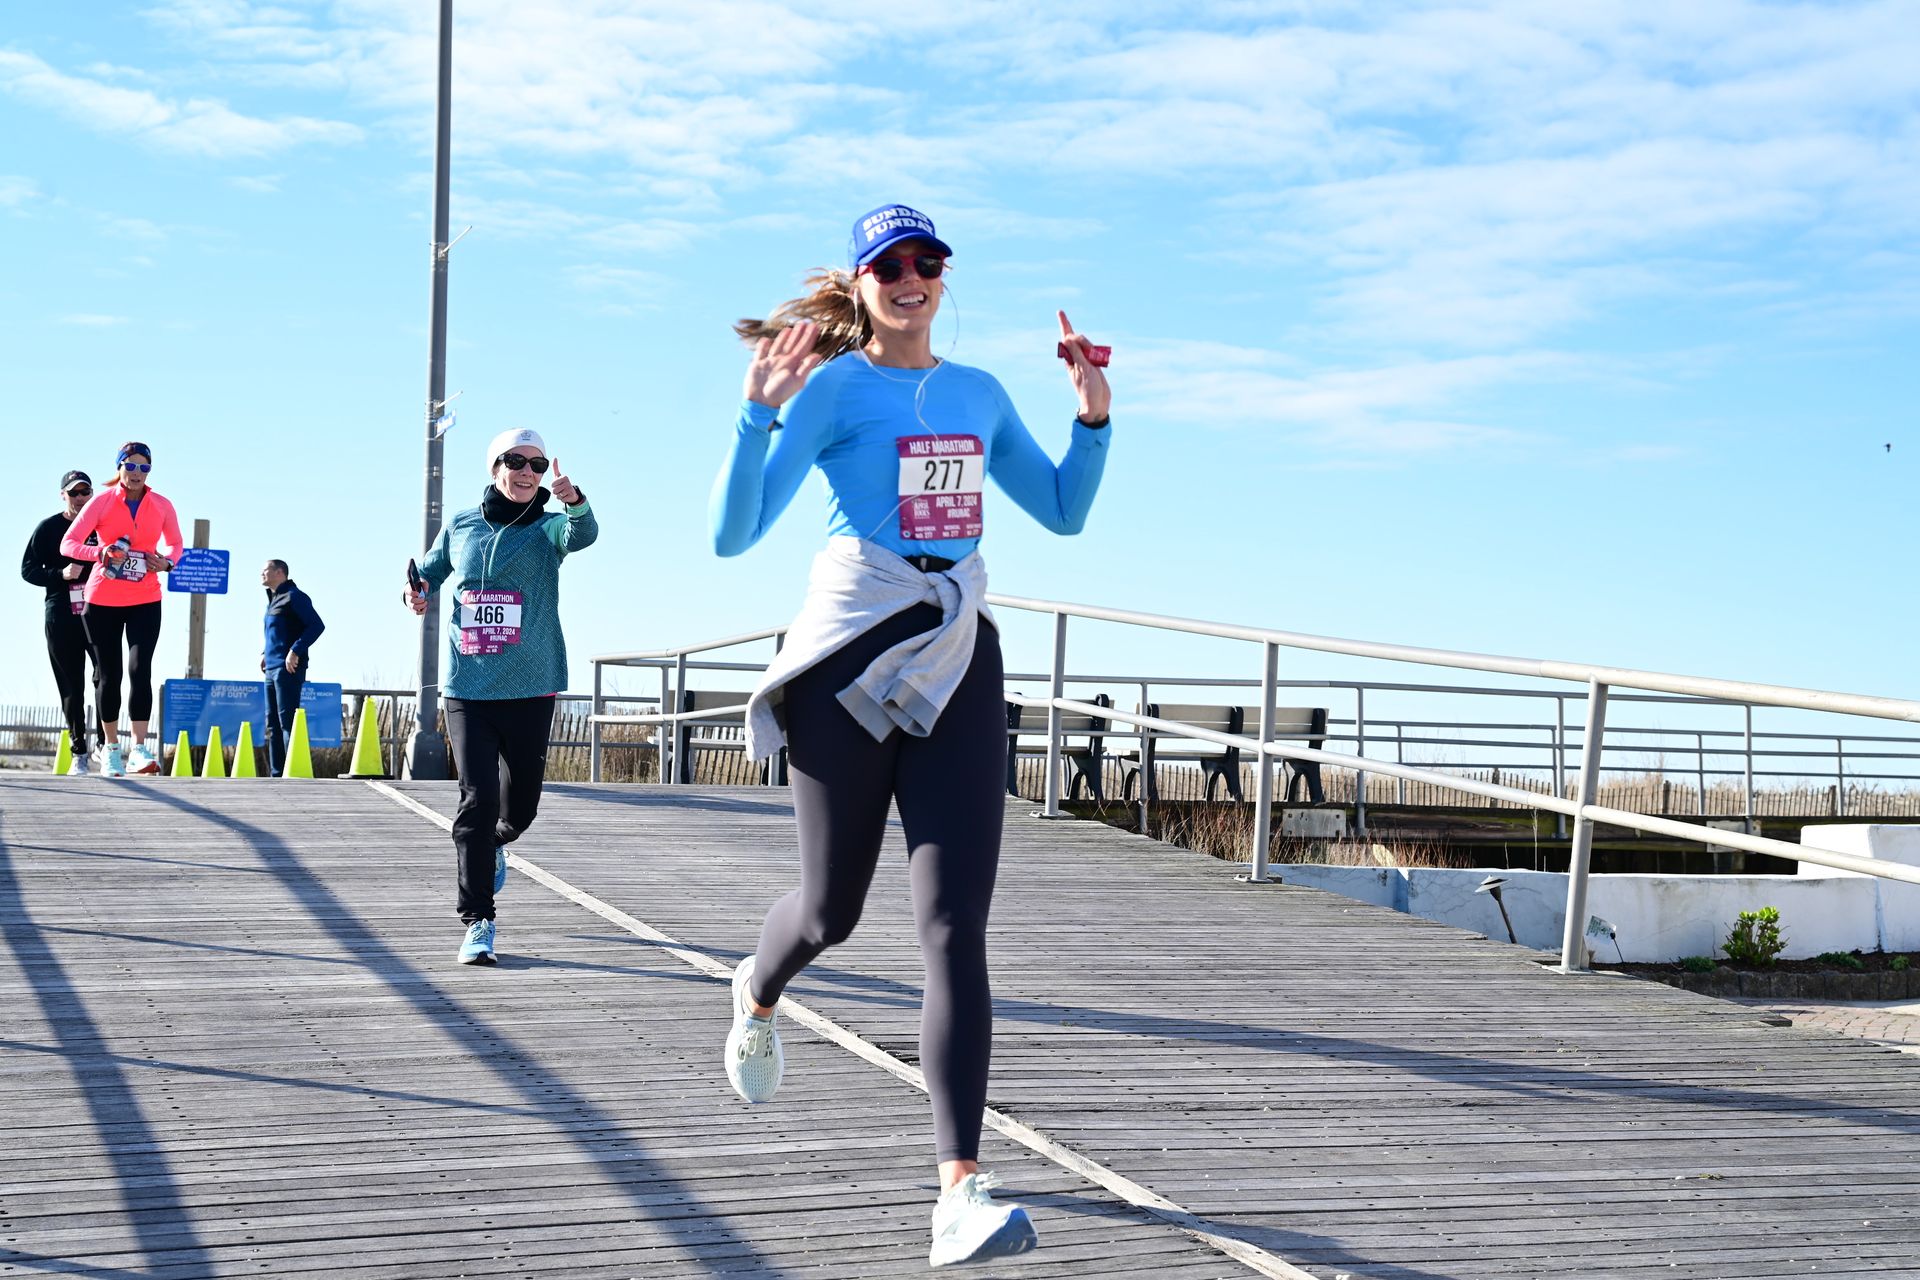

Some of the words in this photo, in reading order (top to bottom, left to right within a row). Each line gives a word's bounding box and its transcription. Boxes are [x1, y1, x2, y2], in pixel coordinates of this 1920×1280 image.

[909, 441, 931, 455] HALF
[932, 440, 975, 454] MARATHON
[924, 459, 964, 491] 277
[936, 496, 956, 508] APRIL
[957, 496, 964, 508] 7,
[964, 495, 978, 507] 2024
[467, 594, 480, 604] HALF
[481, 594, 514, 603] MARATHON
[474, 605, 505, 625] 466
[482, 627, 496, 635] APRIL
[497, 627, 502, 636] 7,
[503, 627, 516, 636] 2024
[211, 684, 259, 693] LIFEGUARDS
